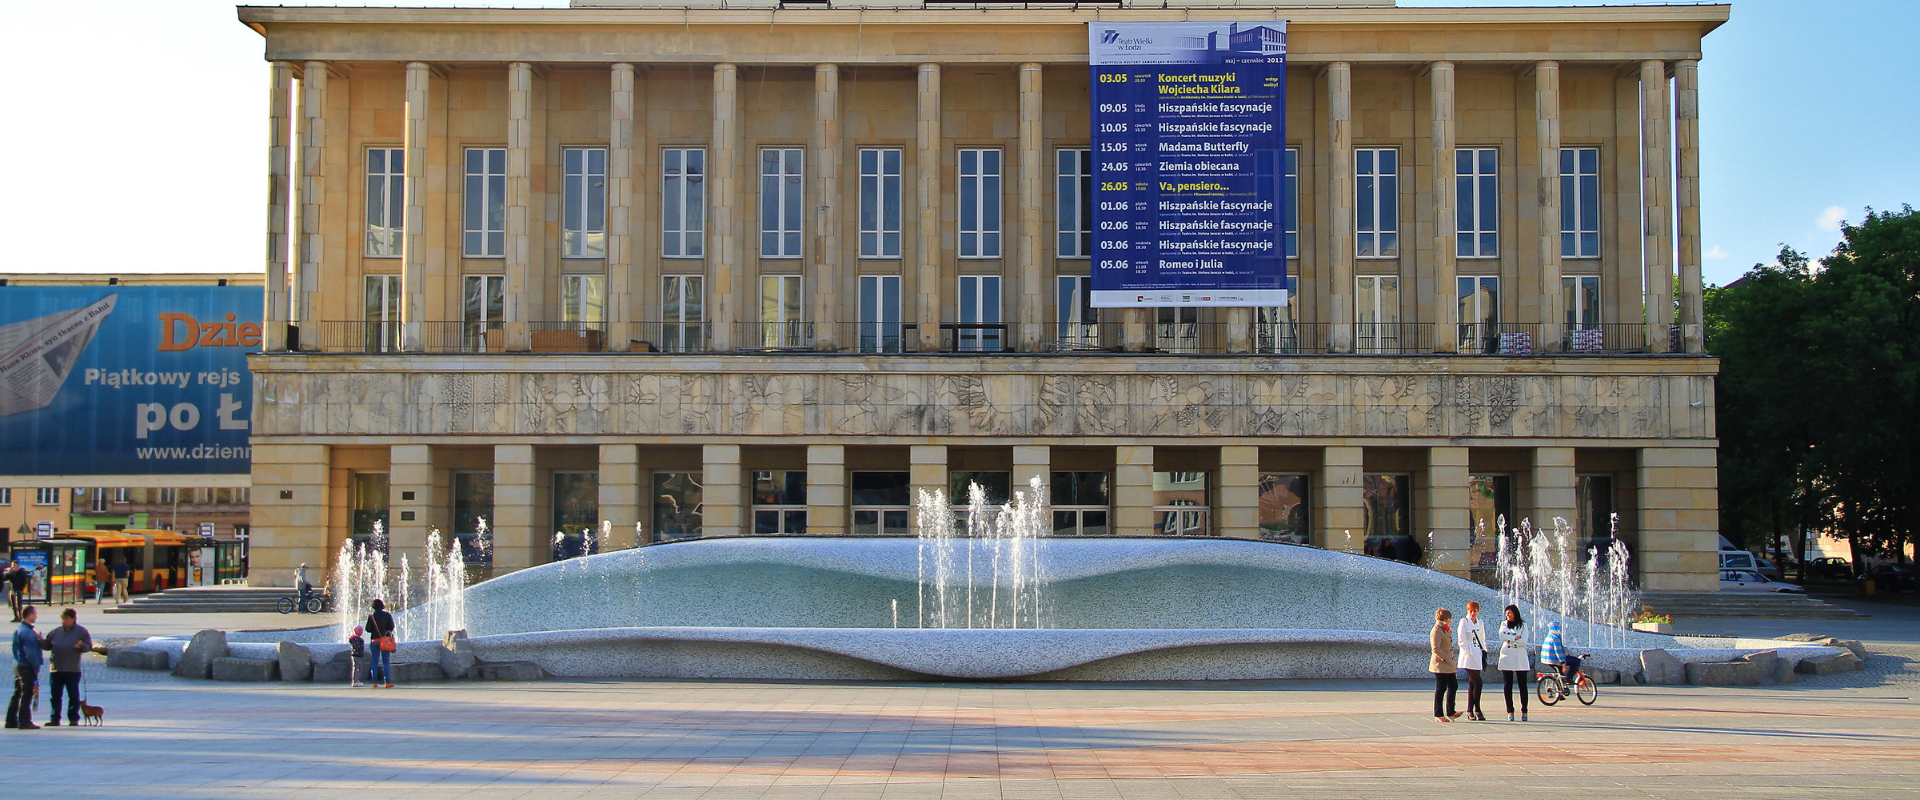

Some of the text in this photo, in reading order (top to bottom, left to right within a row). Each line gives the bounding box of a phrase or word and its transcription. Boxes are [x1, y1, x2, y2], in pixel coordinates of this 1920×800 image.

[1100, 74, 1128, 83] 03.05
[1158, 73, 1235, 84] Koncert muzyki
[1158, 85, 1240, 96] Wojciecha Kilara
[1100, 104, 1127, 112] 09.05
[1158, 102, 1272, 115] Hiszpańskie fascynacje
[1101, 124, 1127, 132] 10.05
[1158, 122, 1272, 135] Hiszpańskie fascynacje
[1101, 143, 1127, 151] 15.05
[1158, 142, 1248, 153] Madama Butterfly
[1102, 163, 1128, 171] 24.05
[1159, 161, 1239, 171] Ziemia obiecana
[1101, 182, 1127, 190] 26.05
[1159, 181, 1229, 193] Va, pensiero...
[1101, 202, 1128, 210] 01.06
[1159, 200, 1272, 213] Hiszpańskie fascynacje
[1101, 221, 1128, 229] 02.06
[1159, 220, 1272, 232] Hiszpańskie fascynacje
[1101, 241, 1128, 249] 03.06
[1159, 240, 1272, 252] Hiszpańskie fascynacje
[1101, 260, 1128, 269] 05.06
[1159, 259, 1223, 269] Romeo i Julia
[158, 312, 264, 351] Dzie
[0, 359, 21, 373] Hans
[20, 345, 45, 361] Kloss,
[44, 336, 59, 347] syn
[59, 319, 84, 337] tkacza
[84, 368, 241, 389] Piątkowy rejs
[136, 402, 200, 439] po
